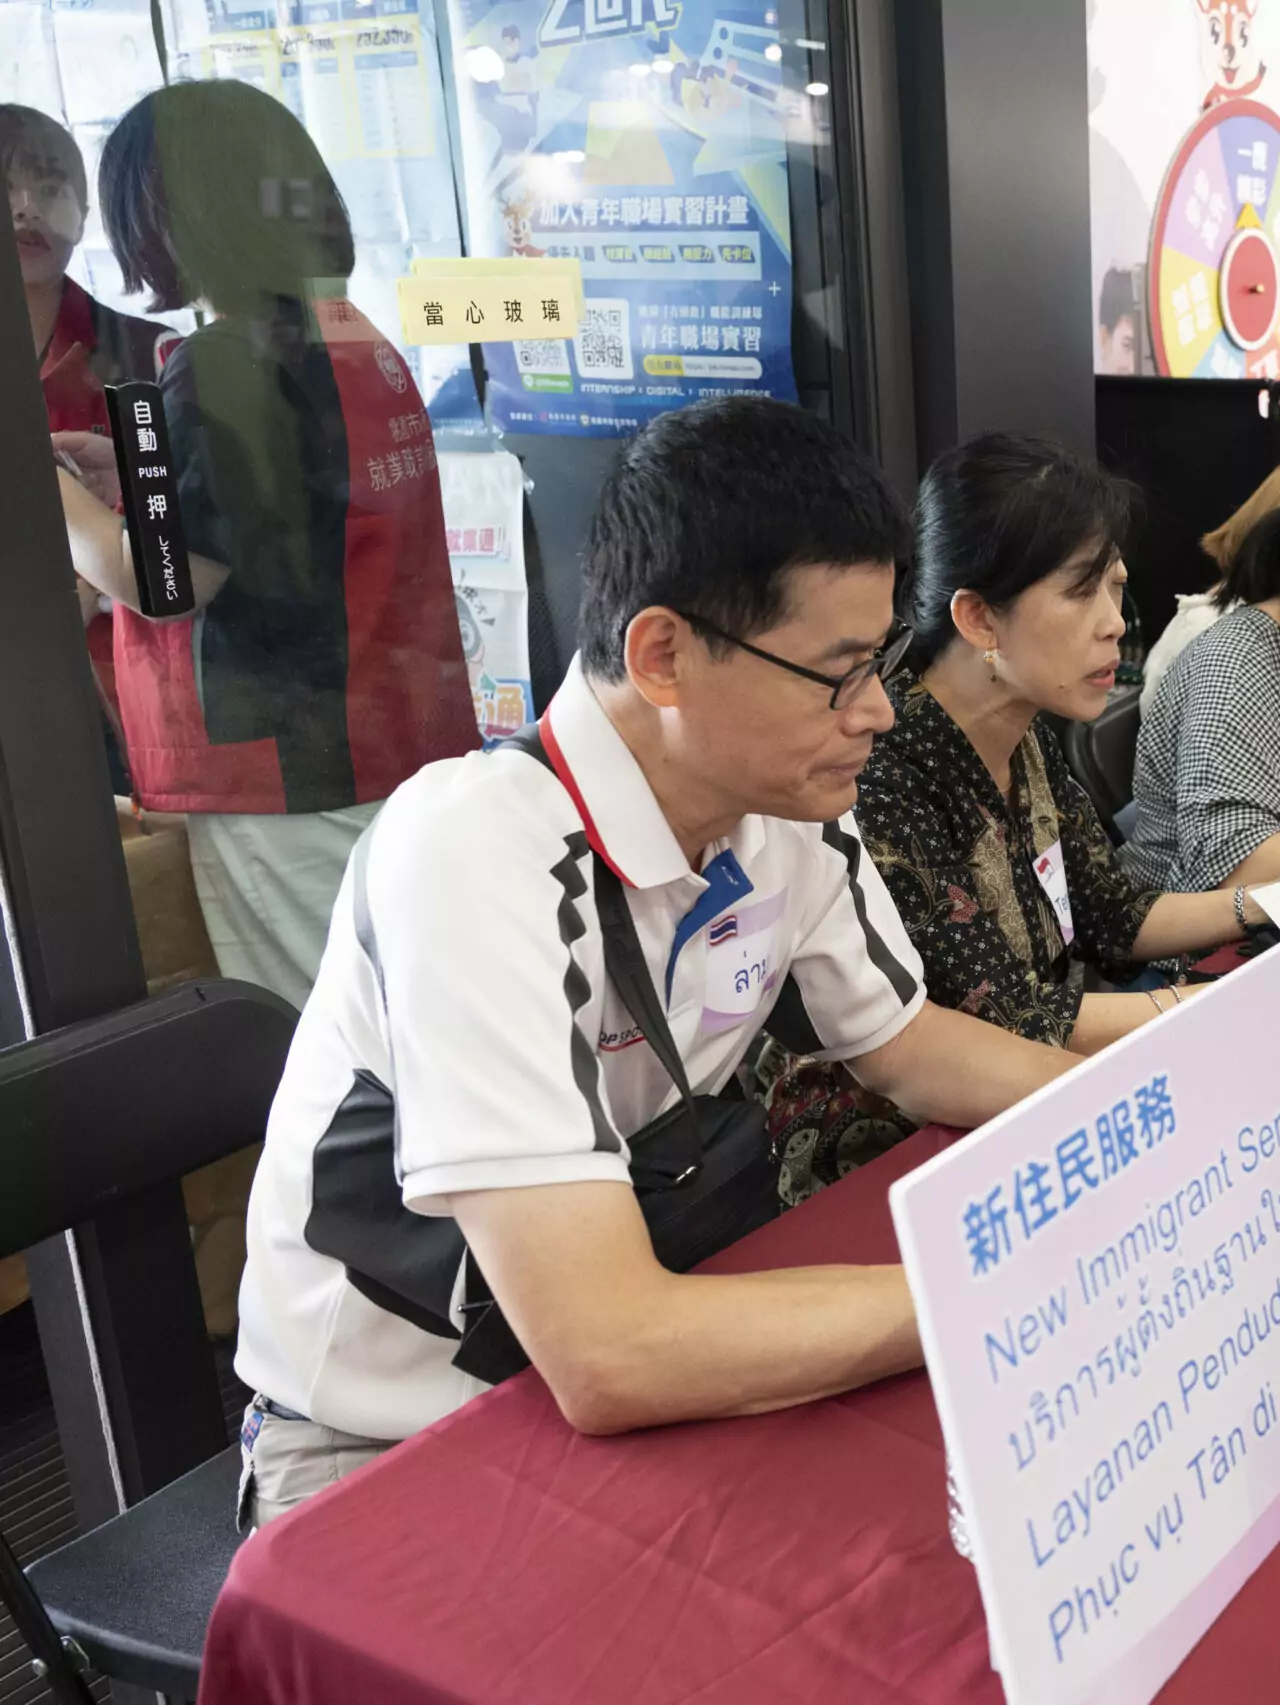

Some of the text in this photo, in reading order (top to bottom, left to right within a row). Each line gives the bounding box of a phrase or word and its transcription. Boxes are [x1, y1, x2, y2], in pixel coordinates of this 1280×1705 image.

[424, 298, 561, 326] 當心玻璃
[133, 400, 158, 452] 自動
[580, 383, 636, 395] INTERNSHIP
[646, 385, 685, 397] DIGITAL
[138, 466, 168, 479] PUSH
[962, 1073, 1178, 1276] 新住民服務
[984, 1291, 1068, 1384] New
[1078, 1148, 1233, 1305] Immigrant
[1026, 1400, 1173, 1568] Layanan
[1048, 1543, 1140, 1663] Phục
[1145, 1493, 1185, 1546] vụ
[1187, 1423, 1247, 1502] Tân
[1252, 1385, 1277, 1437] di
